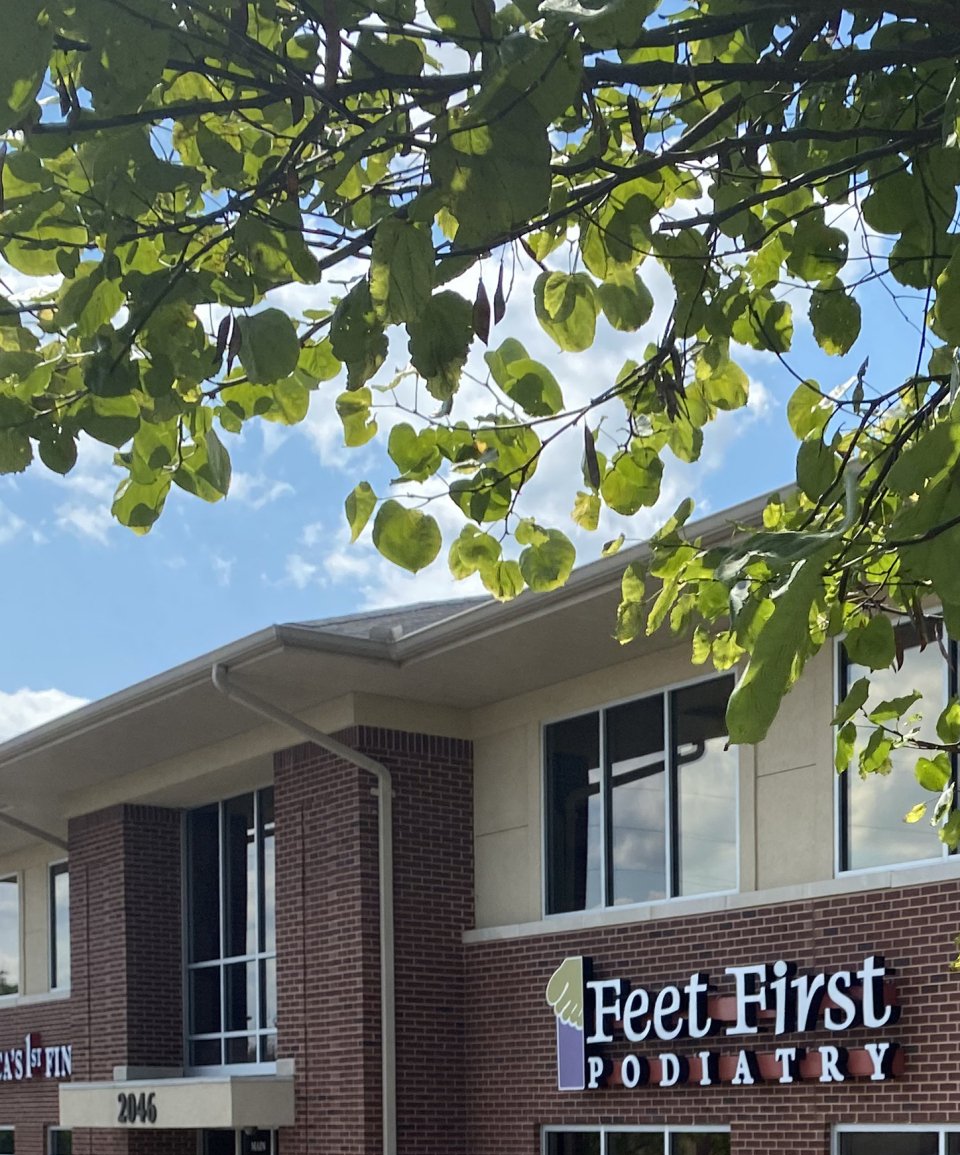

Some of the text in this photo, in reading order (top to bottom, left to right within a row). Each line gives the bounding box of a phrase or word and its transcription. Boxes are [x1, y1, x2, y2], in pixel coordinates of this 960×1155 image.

[586, 955, 892, 1044] Feet First
[45, 1045, 72, 1078] FIN
[587, 1042, 890, 1089] PODIATRY
[117, 1092, 158, 1124] 2046
